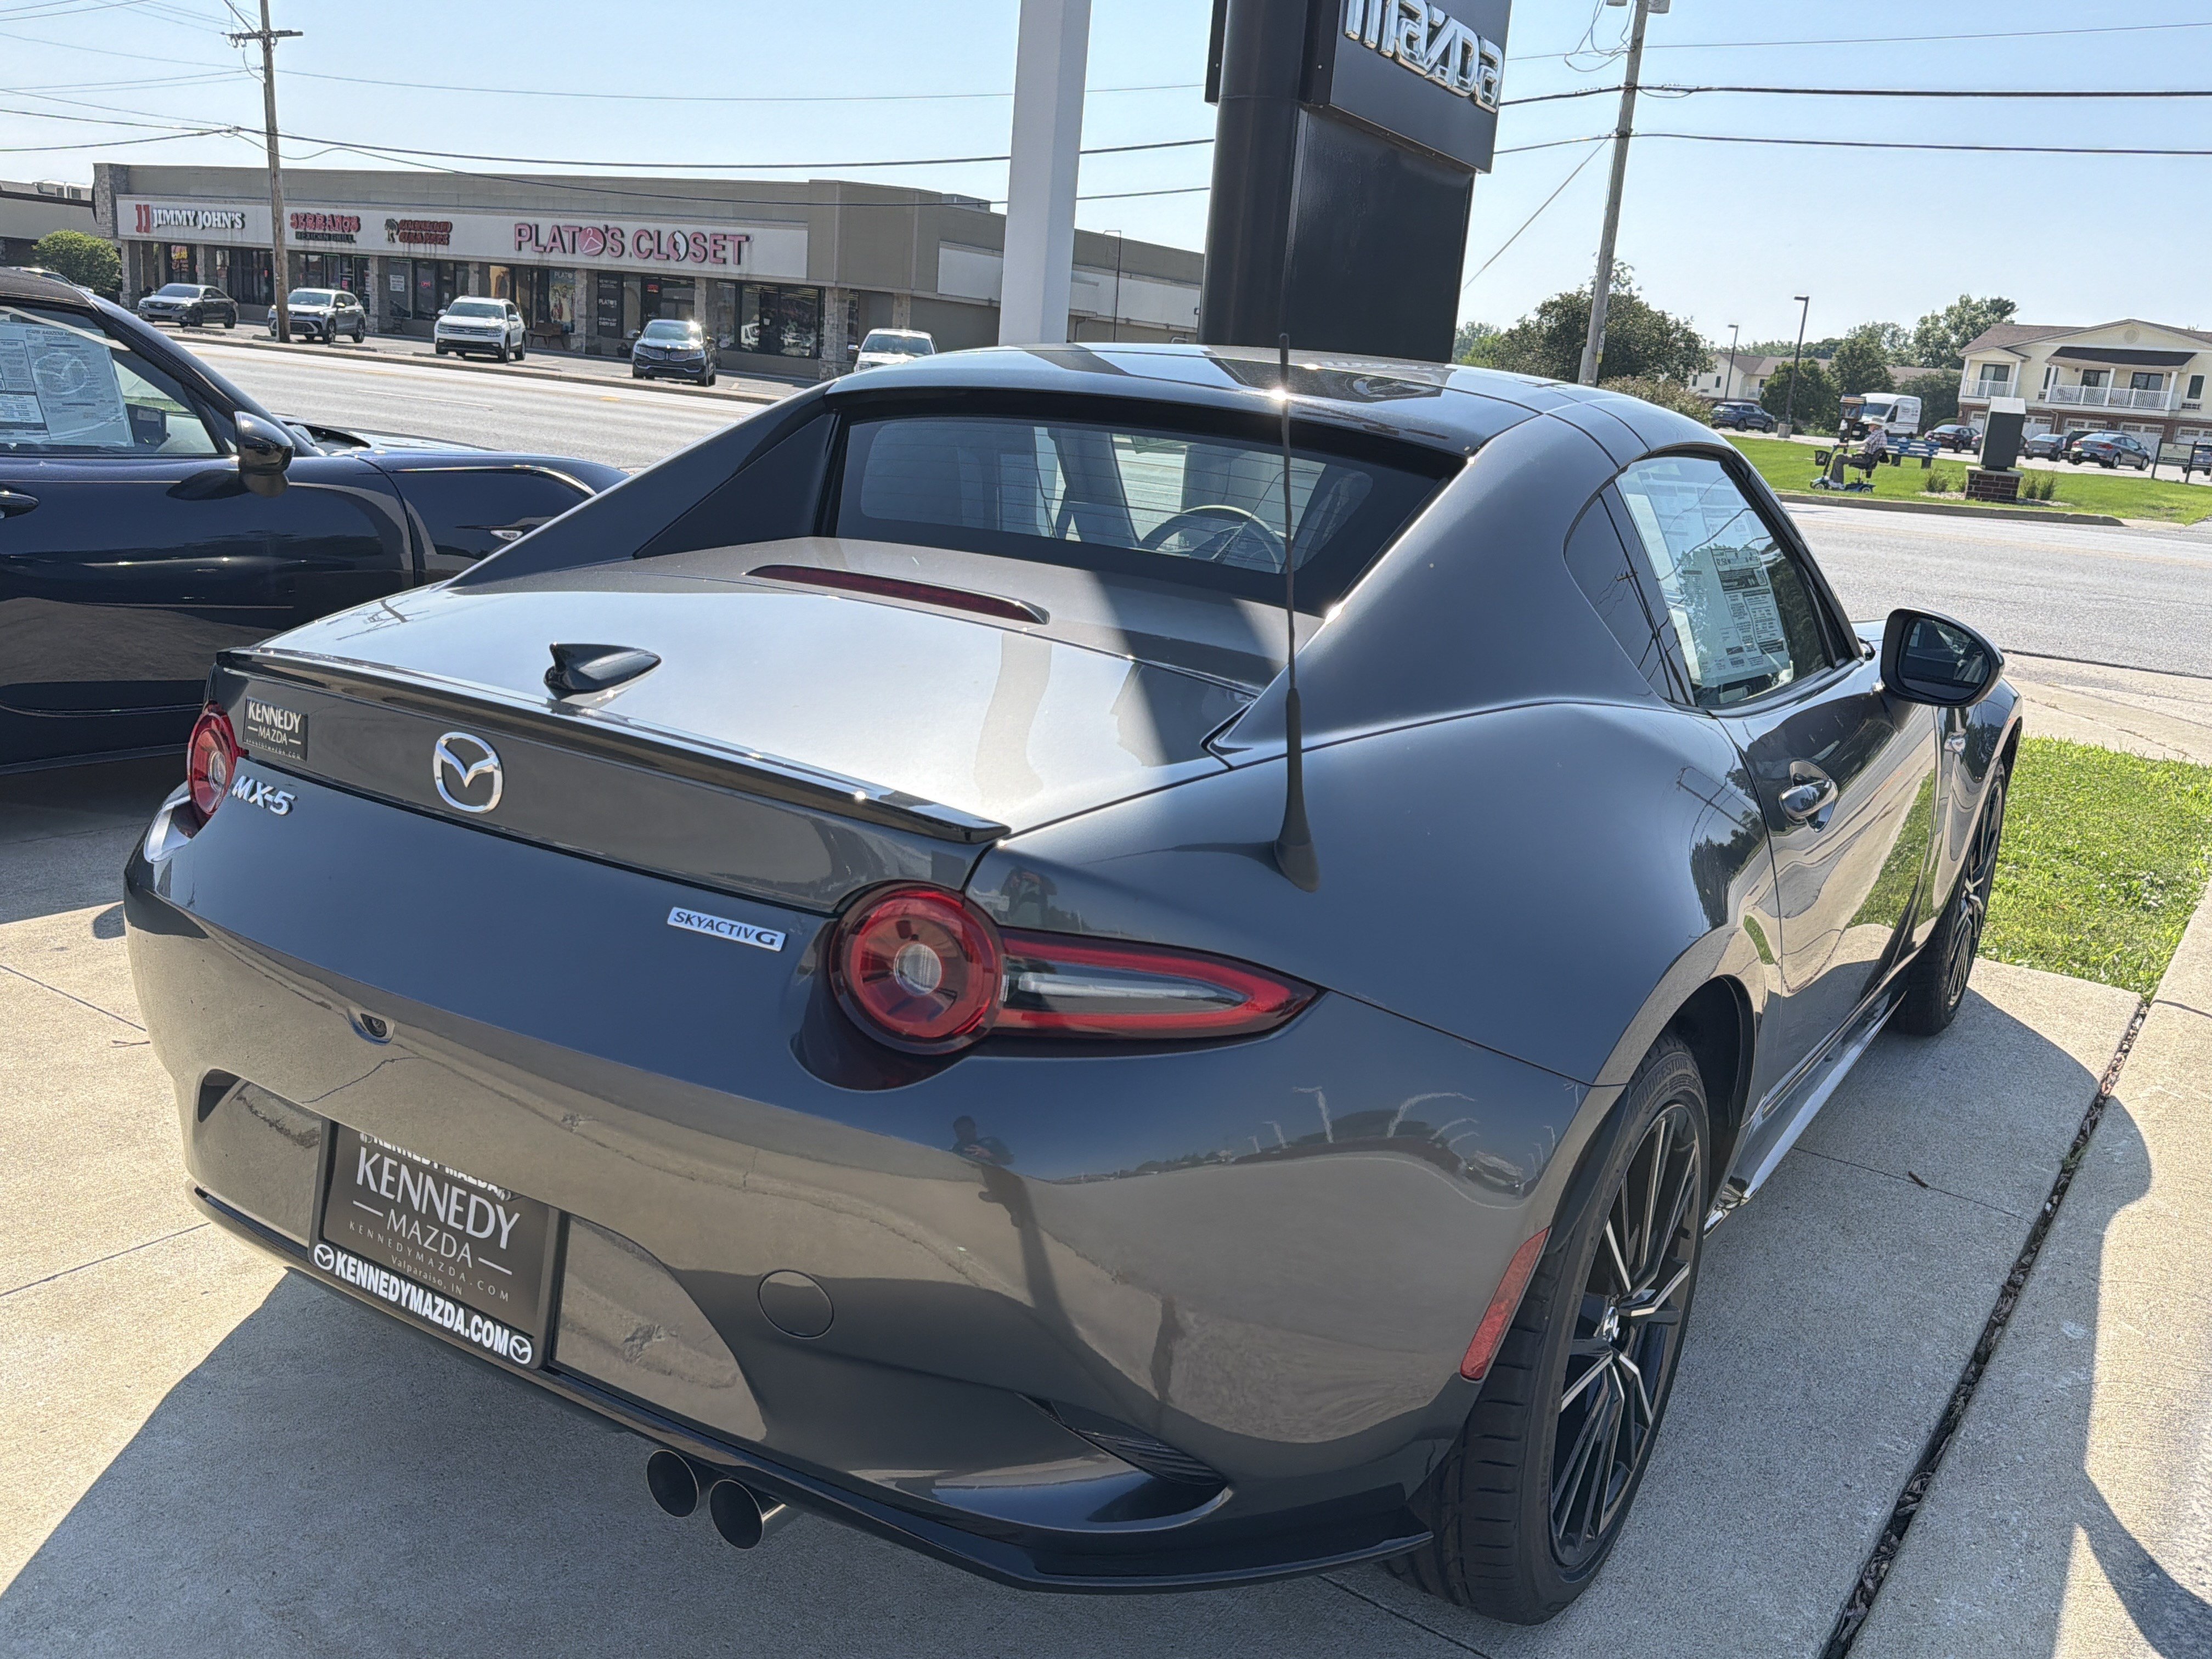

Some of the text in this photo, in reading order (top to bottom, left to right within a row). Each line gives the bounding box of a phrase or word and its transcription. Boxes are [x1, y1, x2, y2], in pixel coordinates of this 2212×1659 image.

[153, 209, 196, 228] JIMMY
[198, 211, 244, 230] JOHN'S
[296, 231, 354, 242] MEXICAN GRILL
[515, 223, 747, 264] PLATO'S CLOSET
[249, 701, 301, 733] KENNEDY
[258, 725, 287, 746] MAZDA
[232, 776, 296, 815] MX-5
[357, 1147, 520, 1250] KENNEDY
[387, 1209, 472, 1268] MAZDA
[349, 1220, 509, 1301] KENNEDYMAZDA.COM
[391, 1255, 462, 1295] Valparaiso, IN
[336, 1251, 510, 1356] KENNEDYMAZDA.COM
